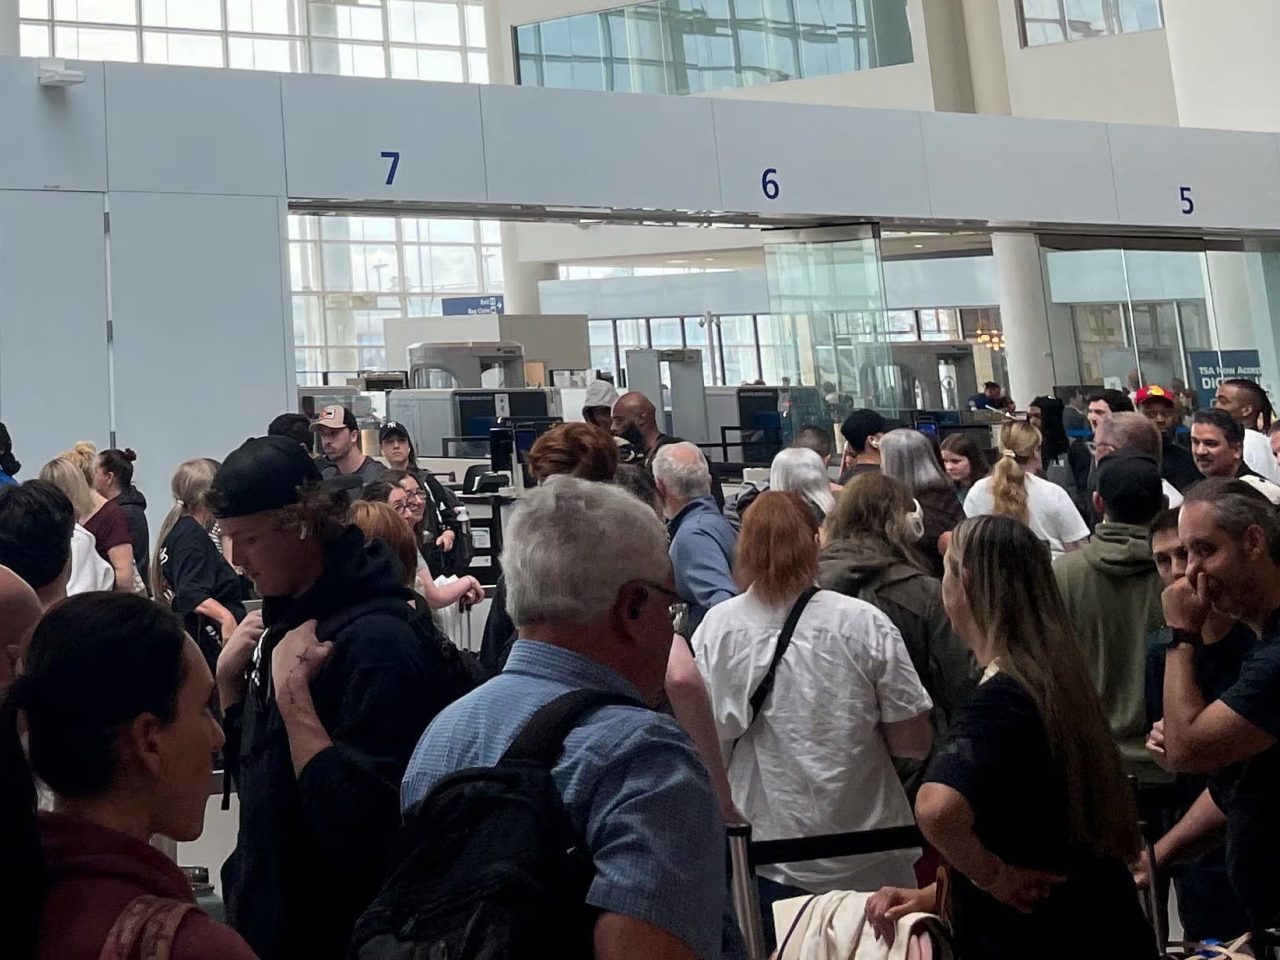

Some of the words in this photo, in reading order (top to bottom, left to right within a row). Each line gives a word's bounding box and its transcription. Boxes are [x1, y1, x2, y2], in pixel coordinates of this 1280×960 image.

[380, 152, 400, 185] 7
[761, 168, 780, 200] 6
[1179, 187, 1194, 215] 5
[1198, 366, 1215, 375] TSA
